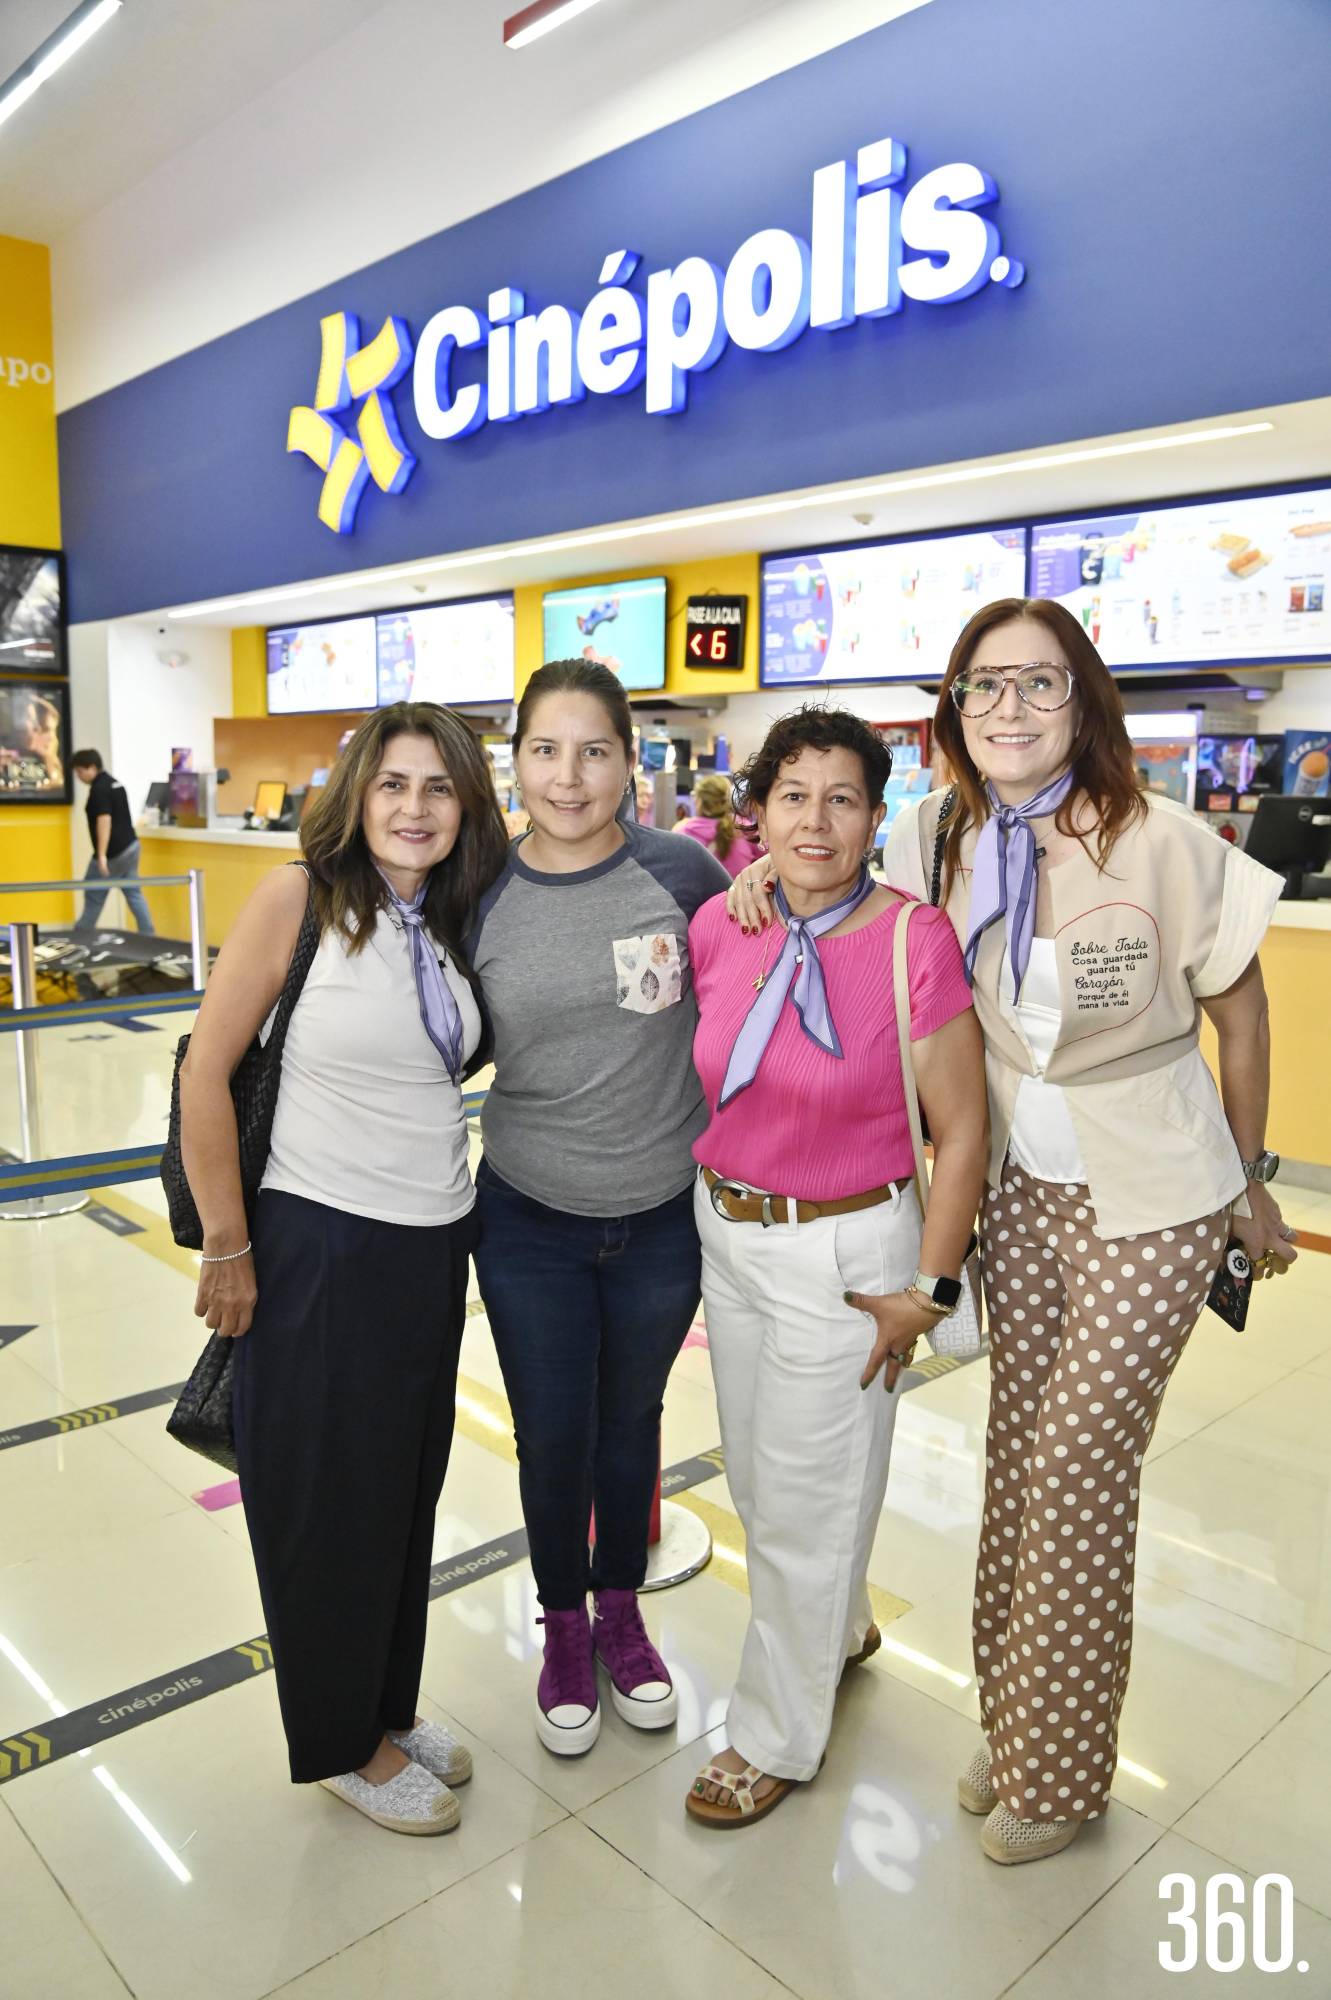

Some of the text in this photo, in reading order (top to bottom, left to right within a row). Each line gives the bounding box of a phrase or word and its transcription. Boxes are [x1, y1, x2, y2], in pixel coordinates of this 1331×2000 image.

[0, 357, 52, 388] po
[711, 630, 726, 659] 6
[1071, 937, 1148, 956] Sobre Toda
[1072, 952, 1148, 965] Cosa guardada
[1087, 962, 1136, 976] guarda tú
[1075, 975, 1124, 992] Corazón
[1078, 989, 1129, 1001] Porque de él
[1078, 1001, 1099, 1010] mana
[1112, 999, 1129, 1007] vida
[97, 1676, 203, 1724] cinépolis
